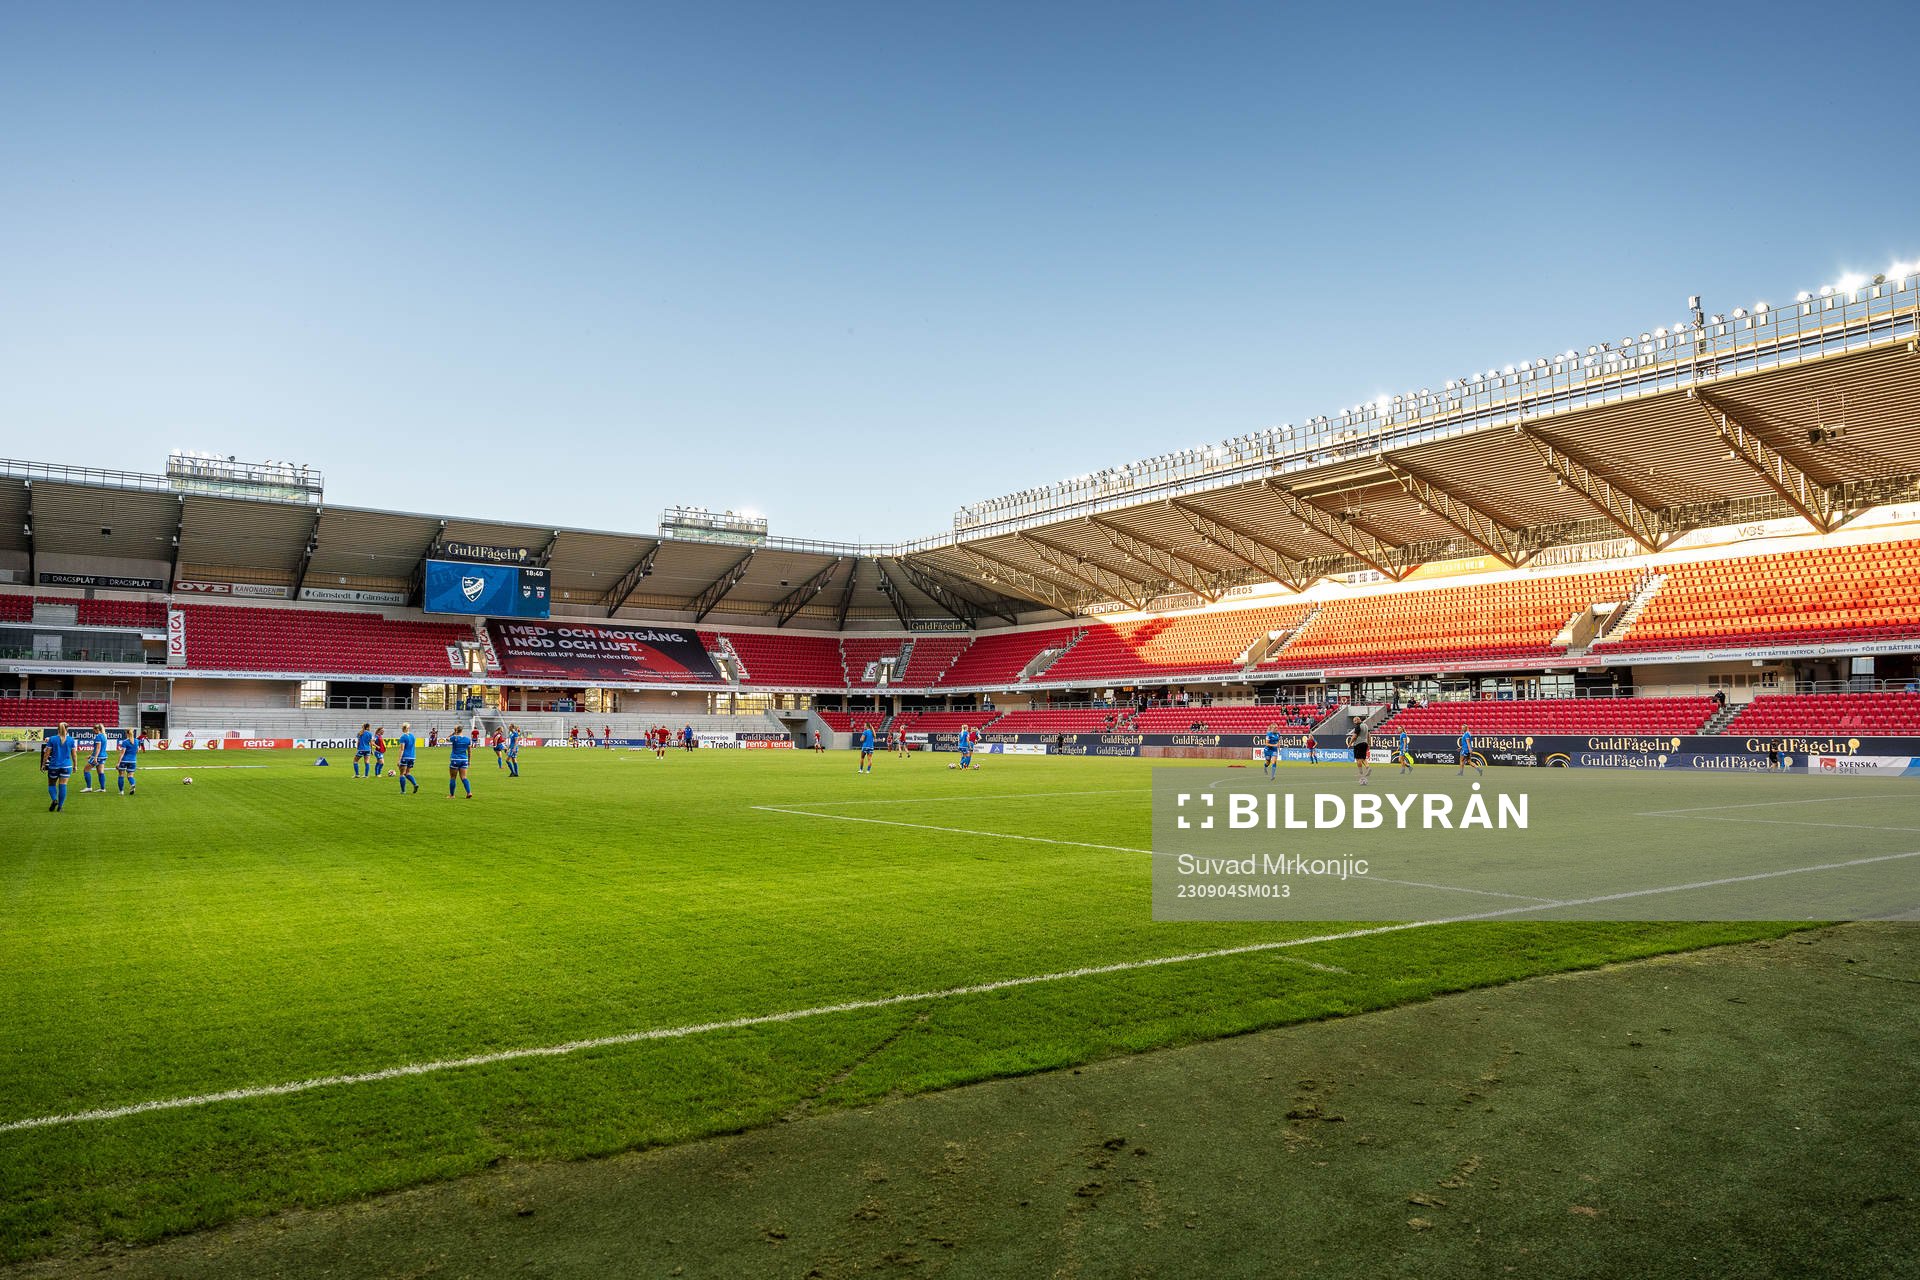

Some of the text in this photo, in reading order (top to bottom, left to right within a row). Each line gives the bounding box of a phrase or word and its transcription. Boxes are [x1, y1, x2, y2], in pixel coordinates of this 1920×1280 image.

[448, 543, 518, 560] GuldFågeln
[52, 575, 95, 584] DRAGSPLÅT
[109, 579, 151, 588] DRAGSPLÅT
[176, 582, 230, 593] OVE
[312, 590, 351, 599] Glimstedt
[362, 593, 400, 602] Glimstedt
[1077, 605, 1105, 615] FOTEN
[171, 614, 182, 632] ICA
[911, 622, 961, 631] GuldFågeln
[499, 625, 688, 643] I MED- OCH MOTGÅNG.
[171, 635, 182, 655] ICA
[503, 636, 643, 652] I NÖD OCH LUST.
[243, 739, 275, 747] renta
[308, 739, 357, 749] Trebolit
[986, 735, 1015, 743] GuldFågeln
[1040, 735, 1074, 743] GuldFeln
[1101, 735, 1139, 745] GuldFågeln
[1172, 735, 1215, 747] GuldFågeln
[1457, 737, 1524, 751] GldFågeln
[710, 741, 741, 749] Trebolit
[1588, 737, 1670, 753] GuldFågeln
[1096, 746, 1131, 756] GuldFågeln
[1288, 751, 1303, 759] Heja
[1415, 752, 1455, 760] wellness
[1492, 753, 1537, 761] wellness
[1581, 754, 1657, 769] GuldFågeln
